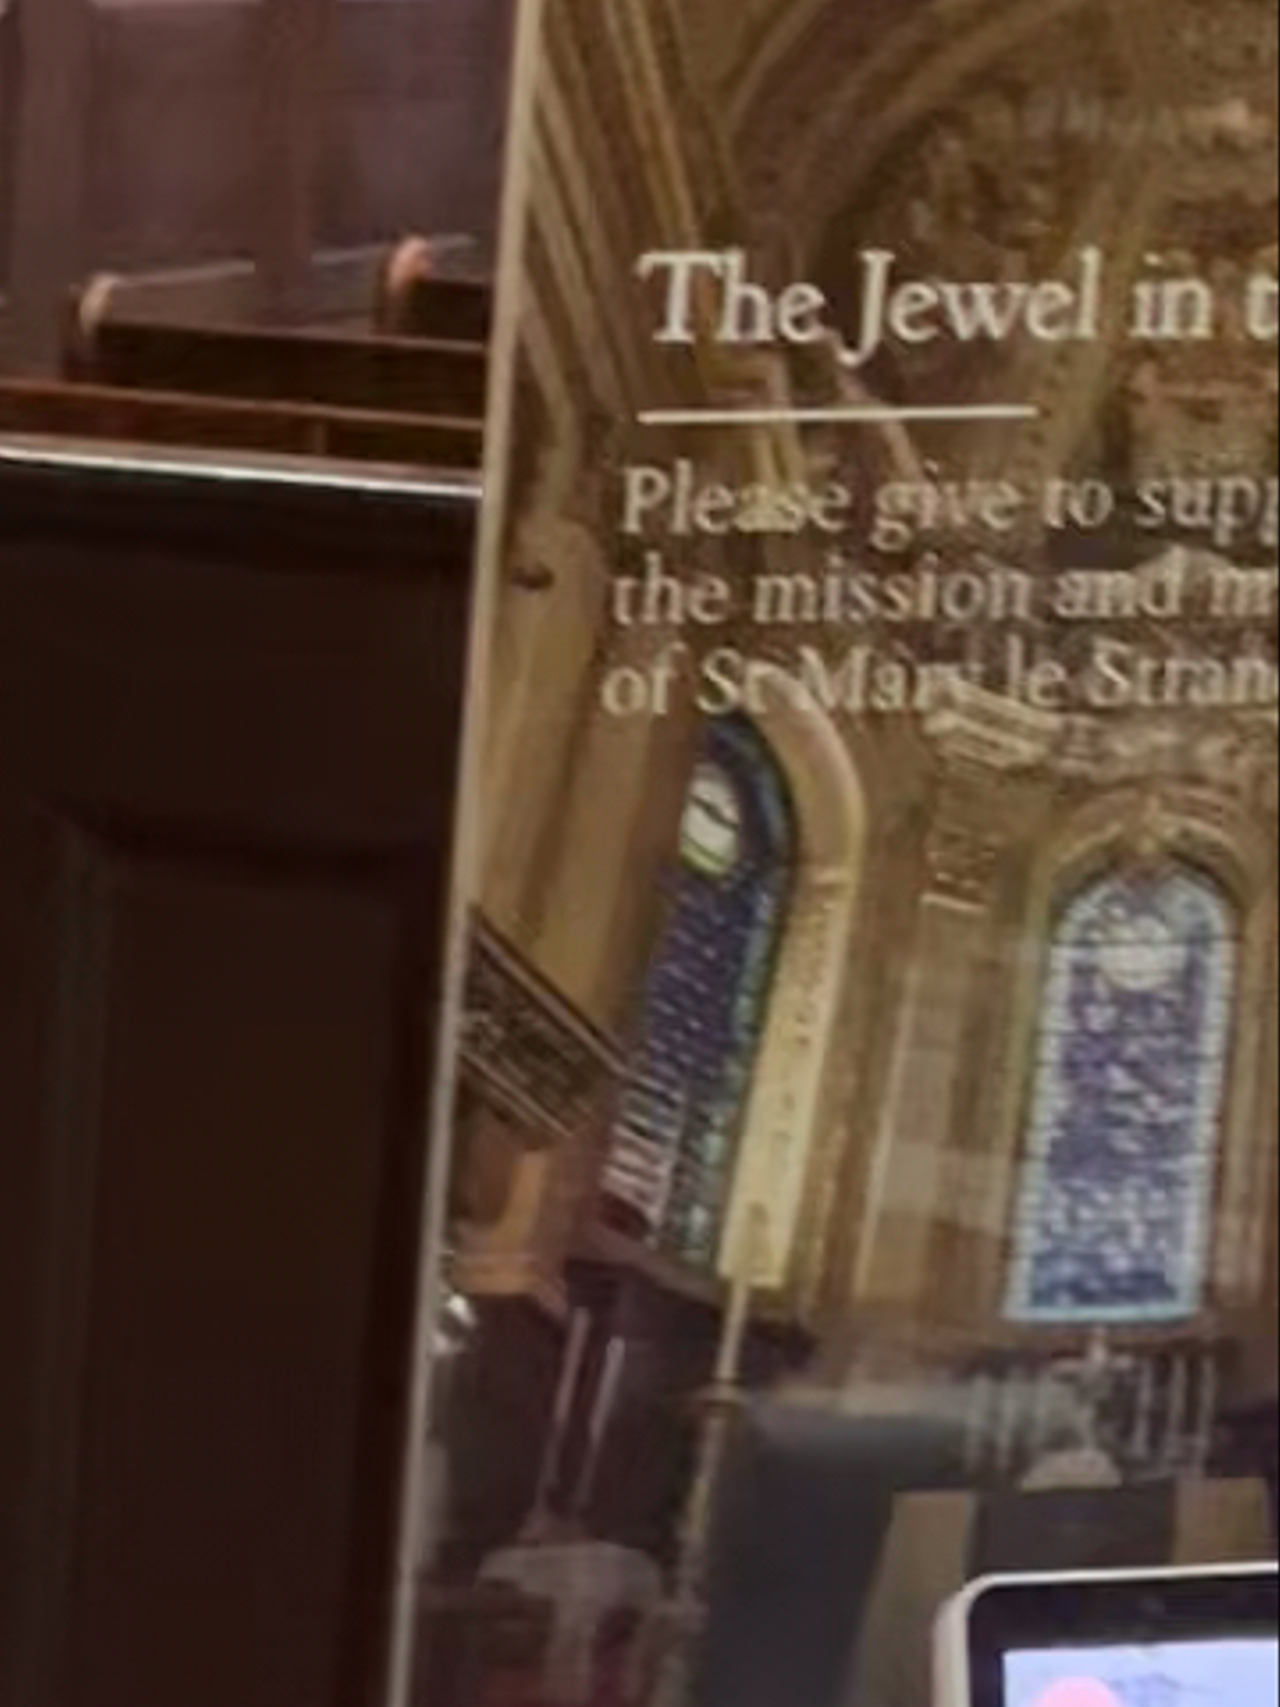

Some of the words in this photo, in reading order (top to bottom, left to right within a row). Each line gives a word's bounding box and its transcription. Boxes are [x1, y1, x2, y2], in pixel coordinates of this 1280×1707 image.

[635, 245, 828, 344] The
[839, 246, 1100, 367] Jewel
[1129, 252, 1215, 341] in
[622, 457, 851, 535] Please
[869, 458, 1023, 552] give
[1040, 478, 1114, 531] to
[612, 549, 731, 625] the
[752, 551, 1036, 626] mission
[1052, 543, 1186, 619] and
[600, 641, 688, 715] of
[696, 647, 767, 714] St
[796, 643, 986, 715] Mary
[1006, 633, 1069, 707] le
